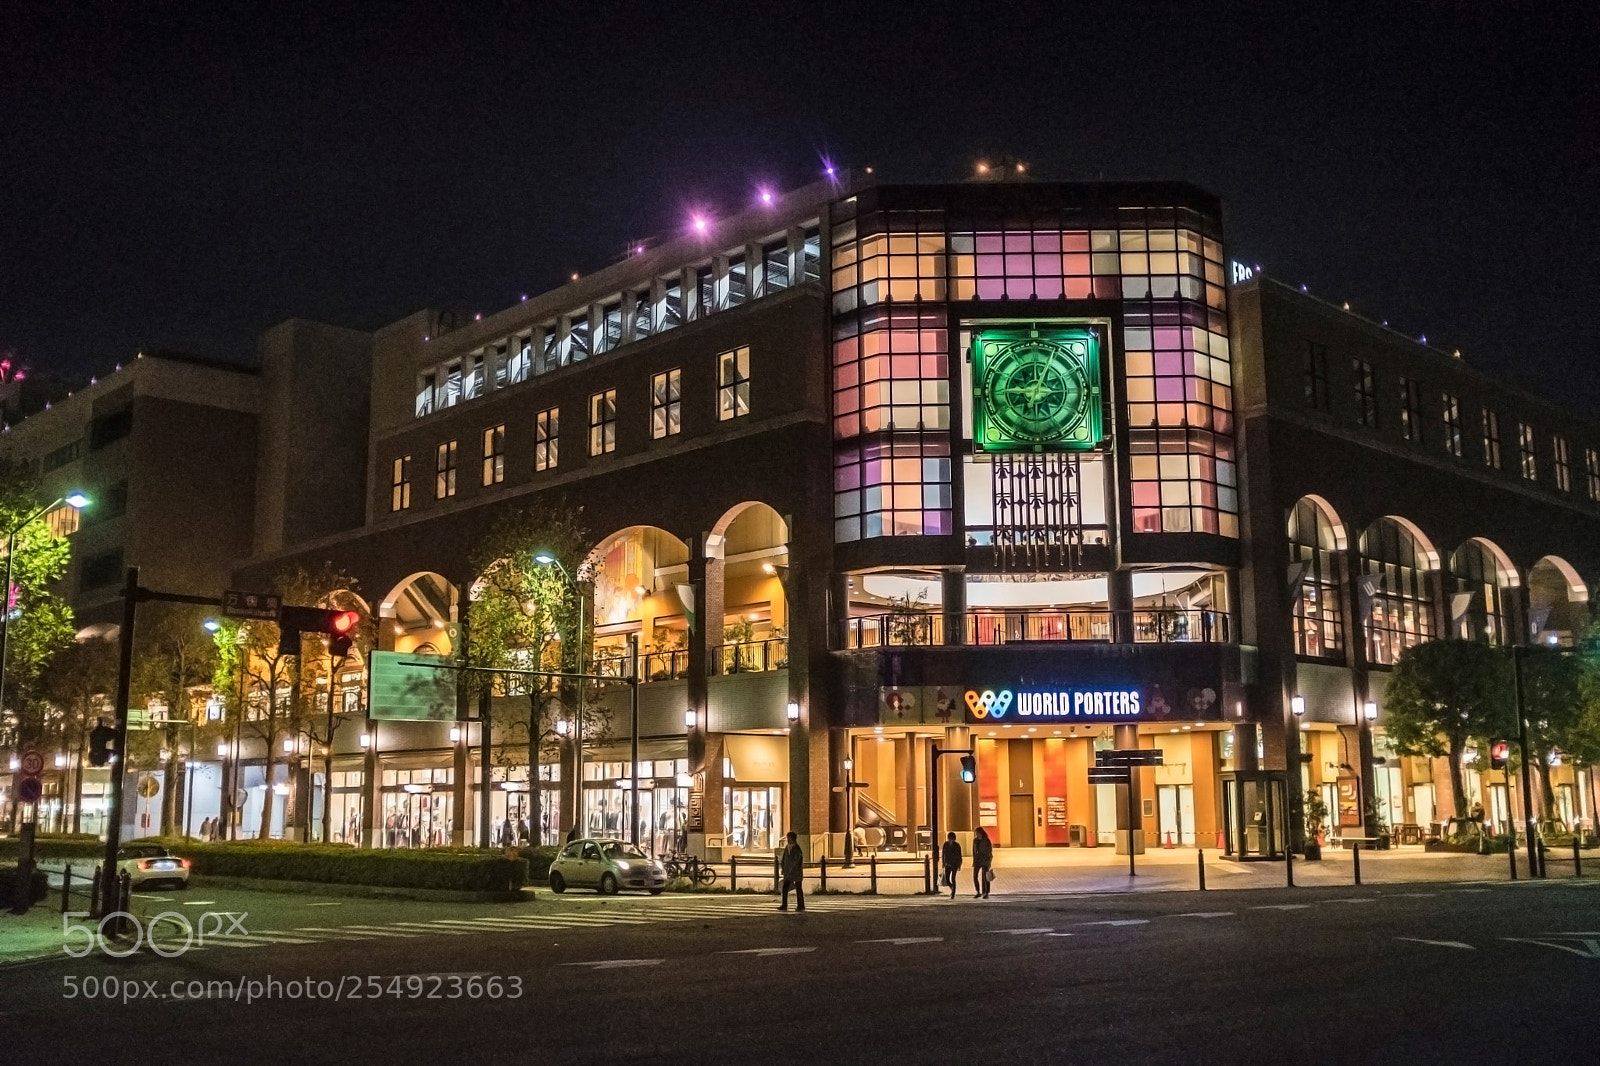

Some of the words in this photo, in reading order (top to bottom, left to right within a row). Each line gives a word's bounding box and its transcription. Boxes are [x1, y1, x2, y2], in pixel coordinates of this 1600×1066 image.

[1017, 692, 1070, 716] WORLD
[1074, 691, 1140, 715] PORTERS
[24, 758, 39, 769] 30
